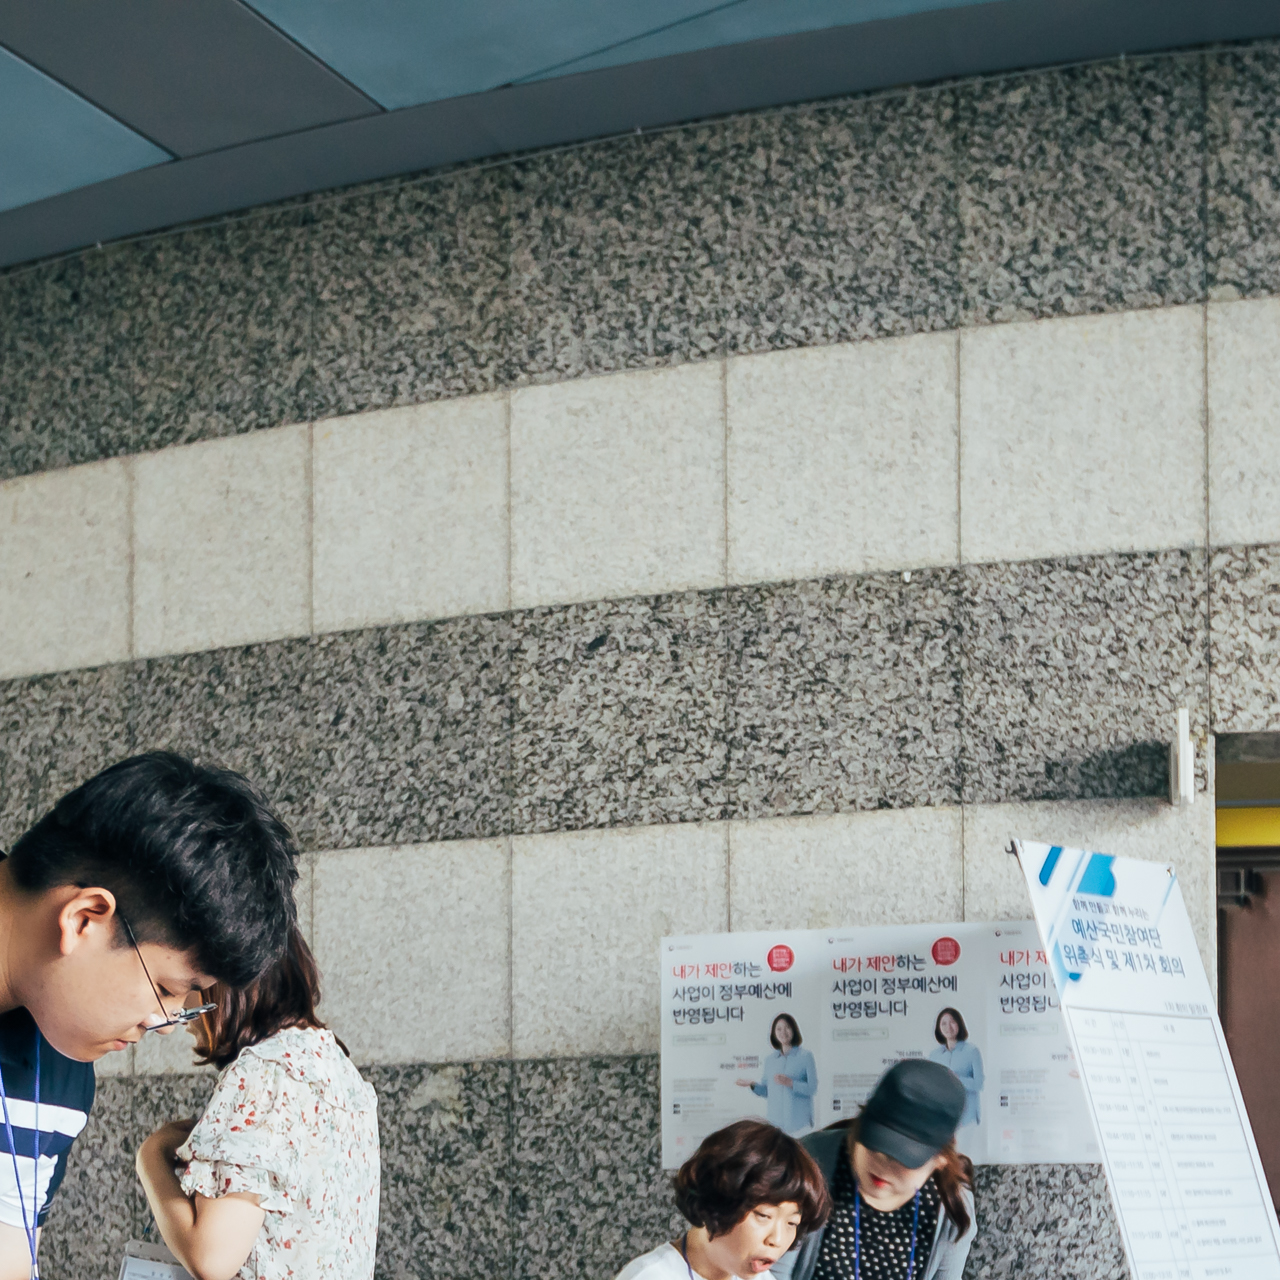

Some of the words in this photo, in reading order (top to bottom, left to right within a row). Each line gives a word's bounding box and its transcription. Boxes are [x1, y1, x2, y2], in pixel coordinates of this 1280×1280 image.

[1071, 918, 1163, 949] 예산국민참여단
[833, 957, 862, 973] 내가
[866, 954, 927, 973] 제안하는
[1000, 950, 1031, 966] 내가
[1063, 944, 1105, 970] 위촉식
[1105, 949, 1122, 971] 및
[1121, 951, 1158, 977] 제1차
[1159, 956, 1187, 979] 회의
[673, 964, 701, 979] 내가
[704, 961, 762, 979] 제안하는
[833, 978, 877, 996] 사업이
[881, 975, 958, 995] 정부예산에
[1000, 972, 1047, 990] 사업이
[673, 985, 715, 1002] 사업이
[719, 982, 792, 1001] 정부예산에
[673, 1006, 744, 1025] 반영됩니다
[832, 1000, 908, 1019] 반영됩니다
